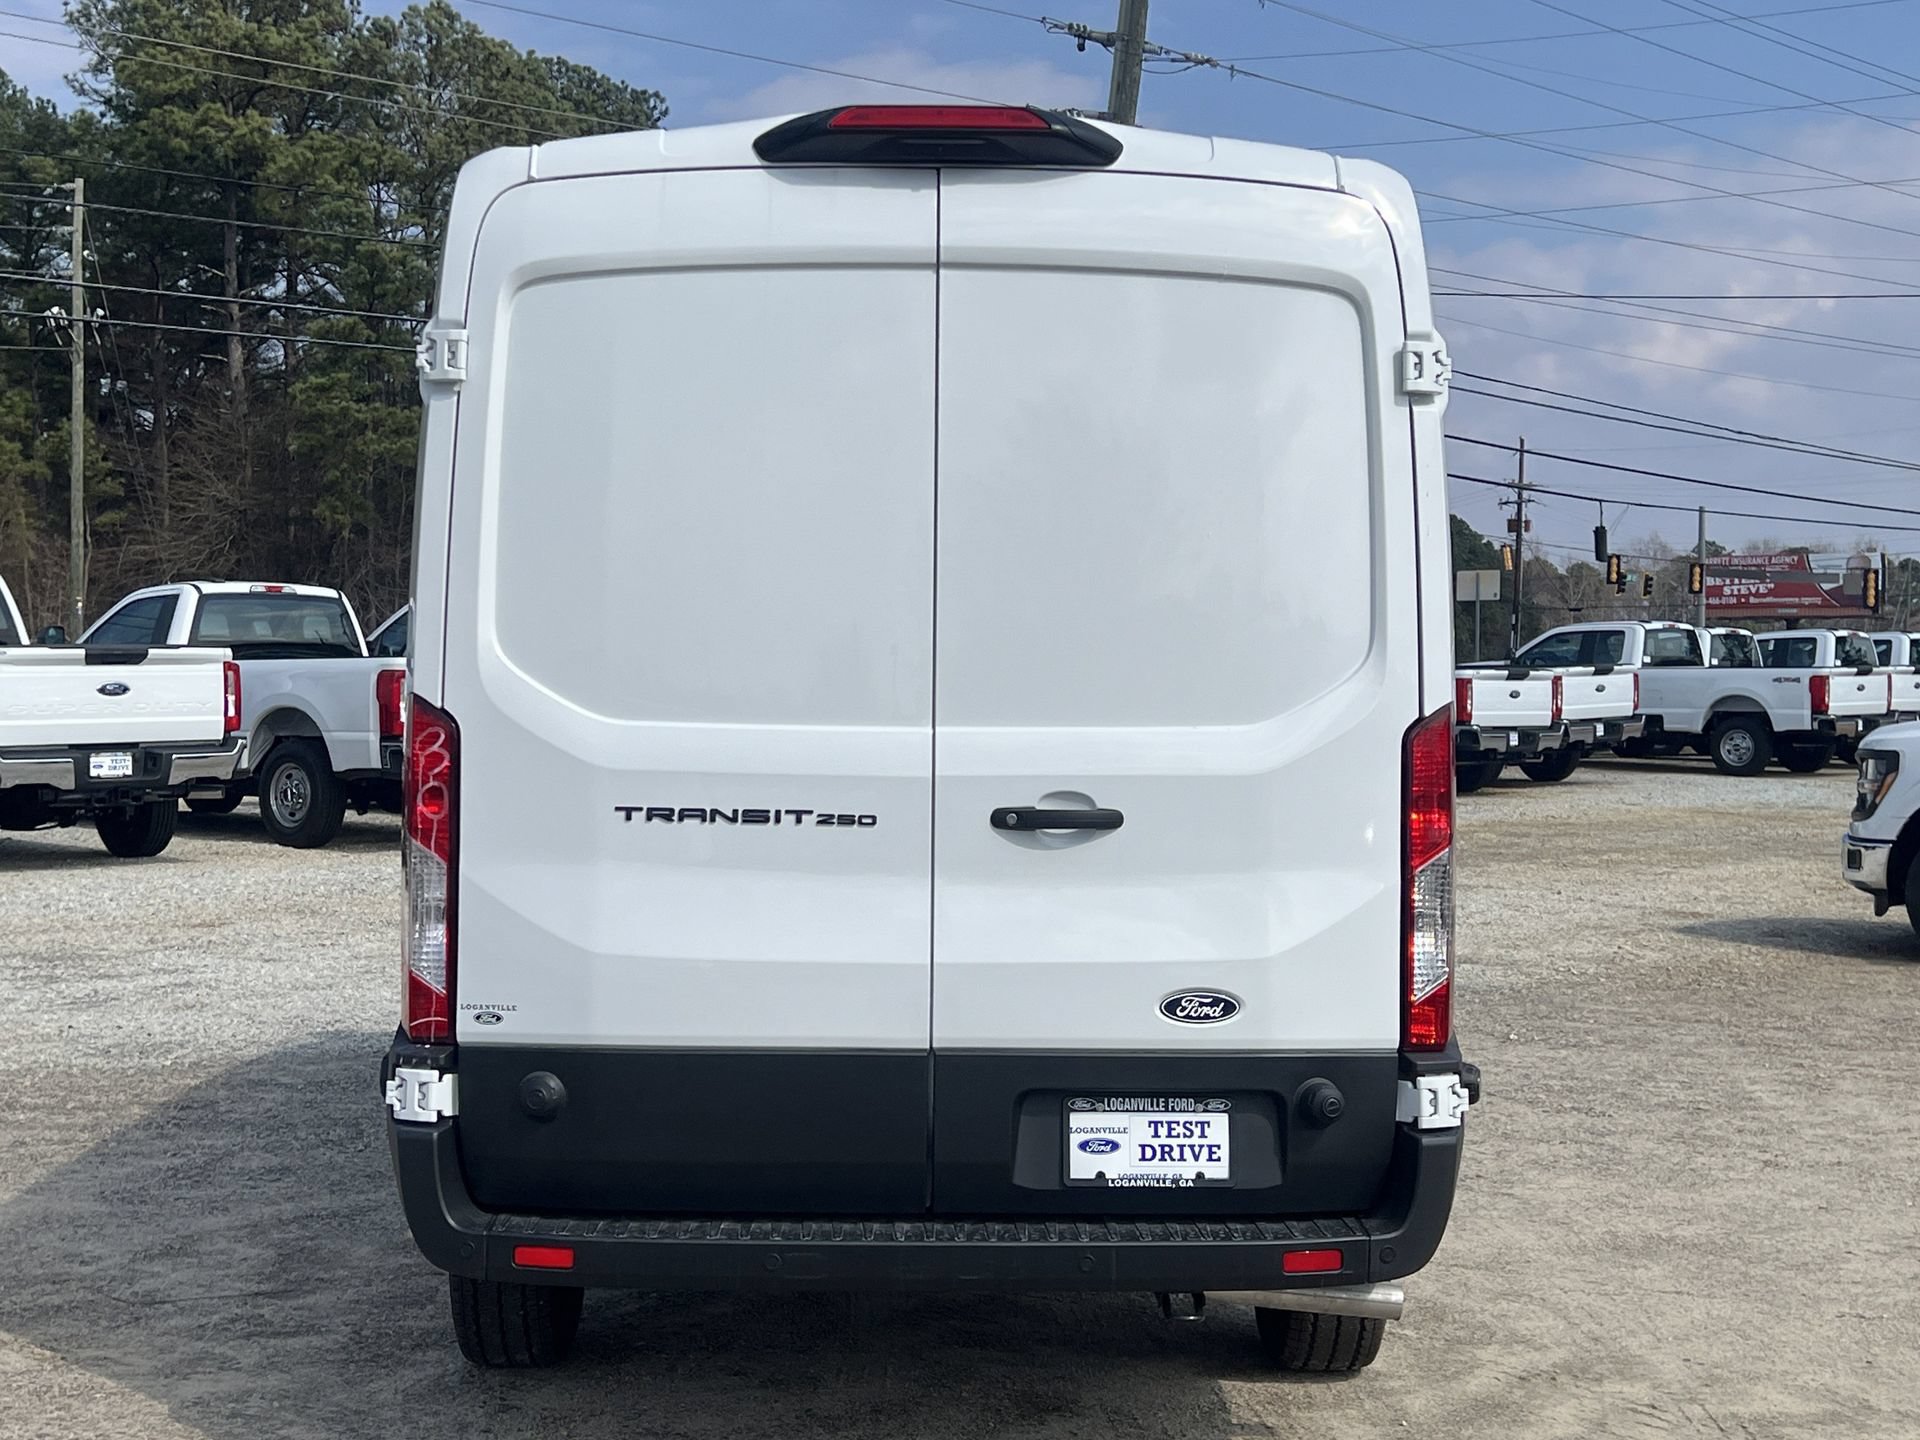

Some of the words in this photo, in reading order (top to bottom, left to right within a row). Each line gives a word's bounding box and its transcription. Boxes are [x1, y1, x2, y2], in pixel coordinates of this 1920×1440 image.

[1731, 556, 1769, 566] INSURANCE
[1771, 555, 1799, 565] AGENCY
[7, 701, 121, 716] SUPER
[132, 700, 214, 713] DUTY
[614, 806, 814, 826] TRANSIT
[816, 812, 878, 827] 250
[460, 1003, 518, 1012] LOGANVILLE
[1174, 995, 1226, 1018] Ford
[1104, 1097, 1165, 1111] LOGANVILLE
[1168, 1097, 1196, 1111] FORD
[1069, 1126, 1129, 1134] LOGANVILLE
[1147, 1120, 1211, 1139] TEST
[1085, 1140, 1113, 1153] Ford
[1138, 1143, 1222, 1162] DRIVE
[1108, 1179, 1177, 1188] LOGANVILLE,
[1178, 1179, 1194, 1187] GA
